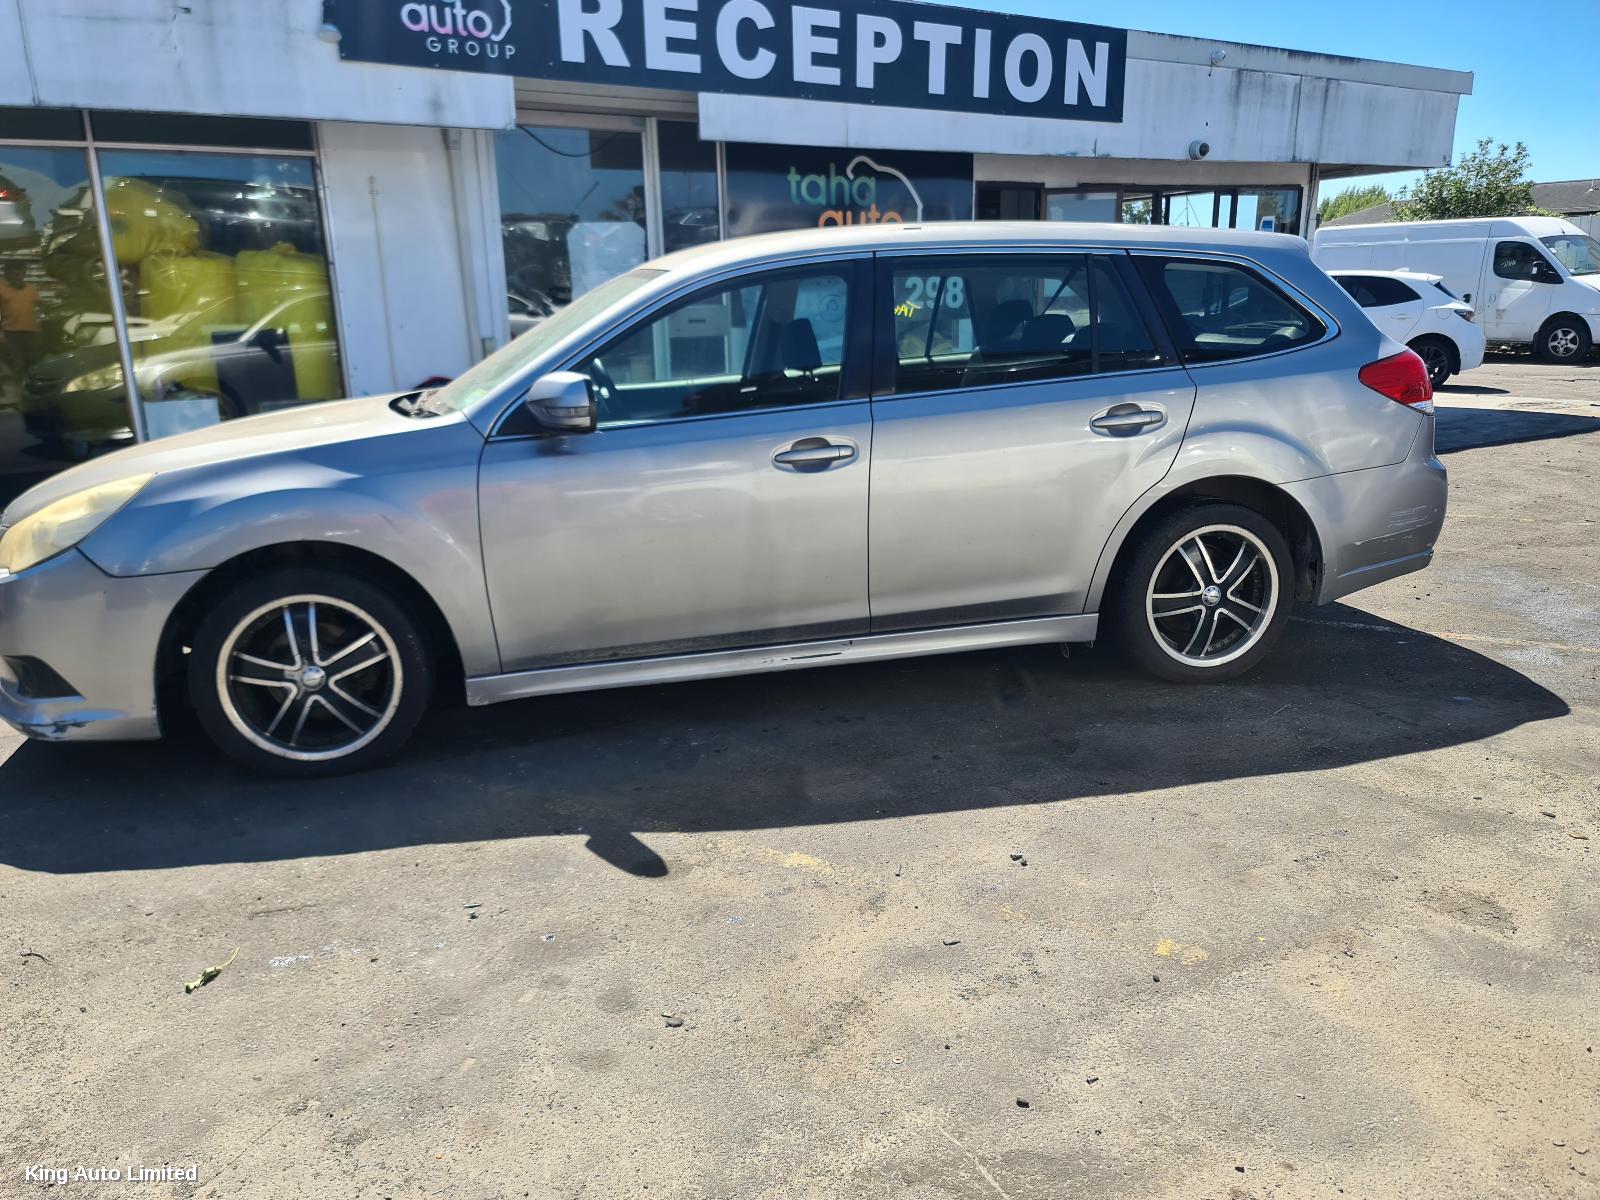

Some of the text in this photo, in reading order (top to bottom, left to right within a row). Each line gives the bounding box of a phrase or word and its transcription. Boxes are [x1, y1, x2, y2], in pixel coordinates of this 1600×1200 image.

[401, 0, 493, 38] auto
[426, 37, 516, 59] GROUP
[556, 0, 1109, 107] RECEPTION
[787, 162, 876, 207] taha
[905, 276, 964, 309] 298
